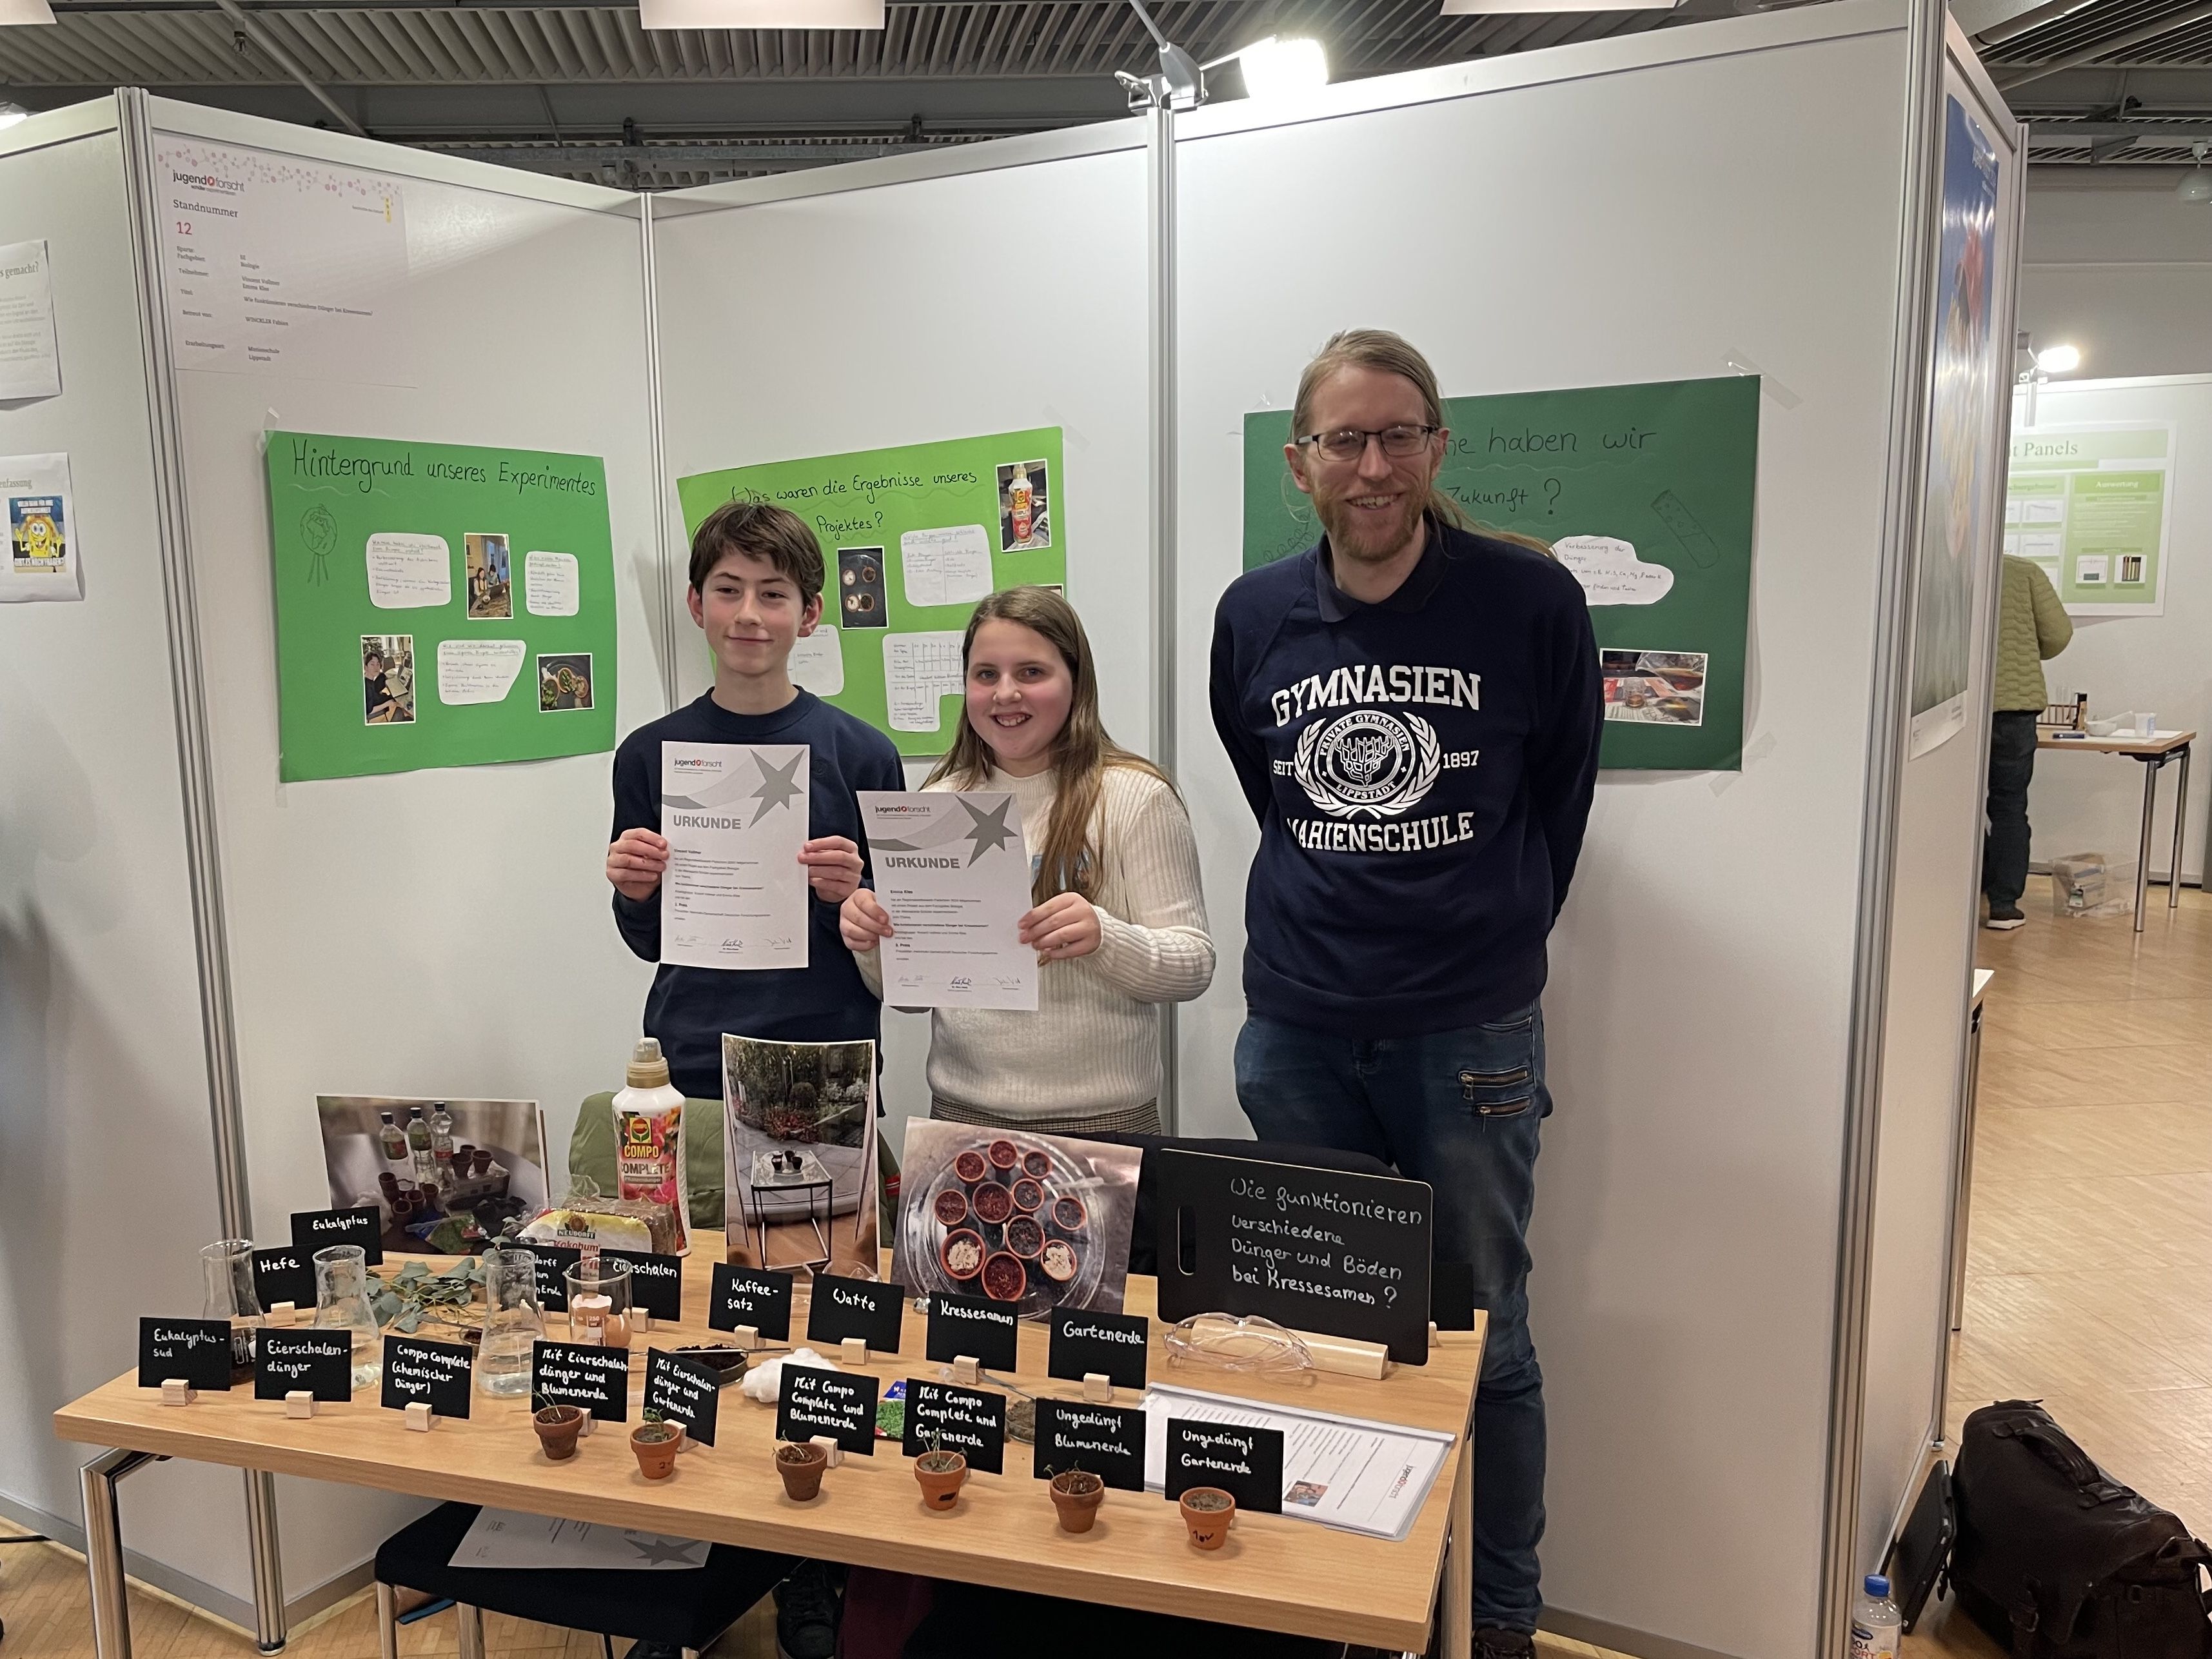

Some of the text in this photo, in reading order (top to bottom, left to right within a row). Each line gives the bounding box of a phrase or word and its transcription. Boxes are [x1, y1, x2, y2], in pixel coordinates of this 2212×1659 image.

[173, 169, 245, 192] jugend forscht
[173, 199, 238, 217] Standnummer
[176, 221, 192, 235] 12
[5, 261, 39, 279] gemacht?
[1489, 427, 1578, 453] haben
[1603, 426, 1657, 449] wir
[2024, 440, 2078, 456] Panels
[293, 438, 596, 497] Hintergrund unseres Experimentes
[776, 486, 818, 499] waren
[822, 477, 847, 495] die
[853, 473, 923, 504] Ergebnisse
[933, 471, 978, 485] unseres
[1447, 486, 1528, 512] Zukunft
[1565, 542, 1609, 554] Verbesserung
[1271, 664, 1481, 728] GYMNASIEN
[1319, 714, 1410, 756] PRIVATE GYMNASIEN
[674, 757, 695, 768] jugend
[1273, 750, 1480, 776] SEIT 1897
[1336, 780, 1397, 799] LIPPSTADT
[874, 805, 901, 813] jugend
[673, 815, 742, 830] URKUNDE
[885, 857, 960, 869] URKUNDE
[624, 1145, 660, 1159] COMPO
[1230, 1177, 1422, 1225] Wie funktionieren
[313, 1215, 369, 1231] Eukalyptus
[1232, 1214, 1345, 1246] verschiedene
[260, 1257, 300, 1273] Hefe
[1232, 1237, 1402, 1280] Dünger und Böden
[731, 1278, 778, 1296] Kaffee-
[1232, 1264, 1260, 1286] bei
[1267, 1268, 1375, 1306] Kressesamen
[727, 1297, 753, 1311] satz
[833, 1288, 876, 1311] Watte
[941, 1299, 1013, 1326] Kressesamen
[1063, 1320, 1145, 1345] Gartenerde
[153, 1347, 173, 1358] sud
[267, 1339, 348, 1356] Eierschalen-
[542, 1349, 562, 1362] Mit
[267, 1359, 311, 1378] dünger
[539, 1364, 606, 1385] dünger und
[656, 1358, 670, 1372] Mit
[395, 1378, 431, 1395] Dünger)
[542, 1383, 608, 1400] Blumenerde
[654, 1375, 699, 1400] dünger und
[795, 1376, 855, 1399] Mit Compo
[919, 1386, 939, 1400] Mit
[945, 1391, 982, 1409] Compo
[653, 1391, 696, 1419] Gartenerde
[791, 1392, 864, 1416] Complete und
[790, 1408, 857, 1431] Blumenerde
[917, 1404, 997, 1427] Complete und
[1056, 1409, 1122, 1433] Ungedüngt
[916, 1423, 984, 1447] Gaenerde
[1054, 1433, 1131, 1455] Blumenerde
[1182, 1429, 1254, 1456] Ungedüngt
[1181, 1453, 1252, 1475] Gartenerde
